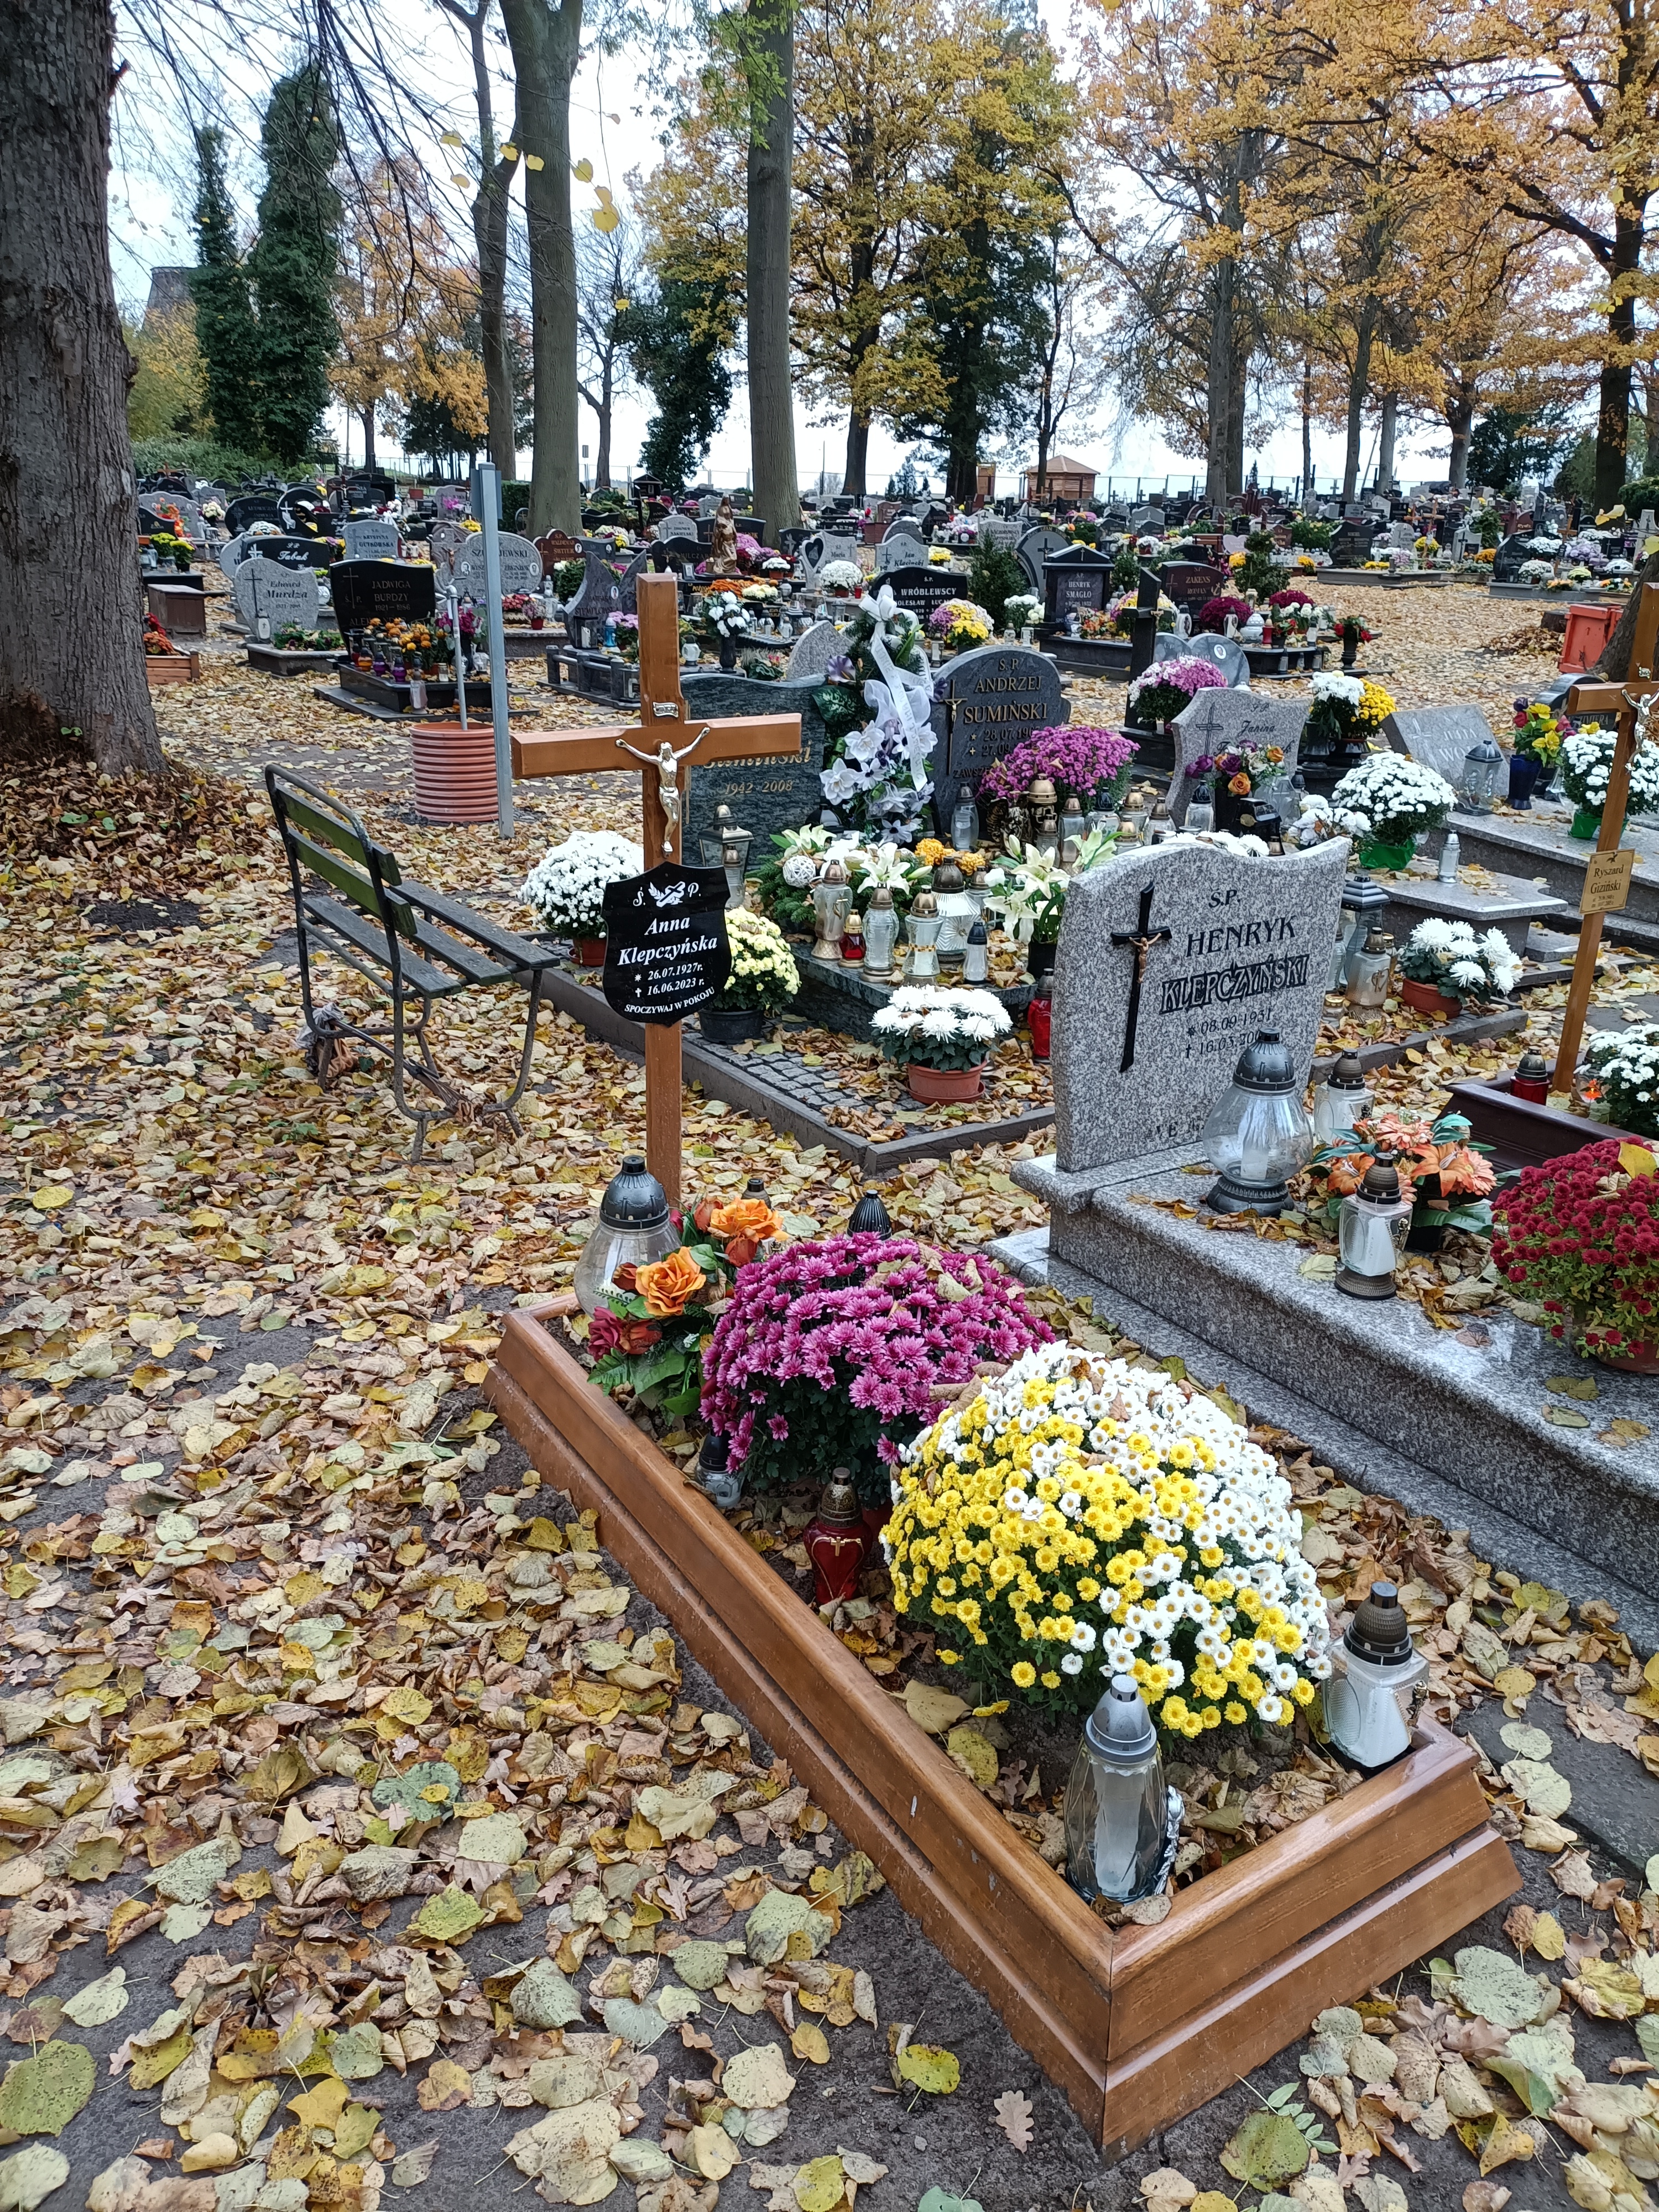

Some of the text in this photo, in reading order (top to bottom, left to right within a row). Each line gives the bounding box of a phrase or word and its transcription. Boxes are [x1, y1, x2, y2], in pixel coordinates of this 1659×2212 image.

[372, 580, 411, 589] JADWIGA
[901, 587, 957, 596] WRÓBLEWSCY
[374, 593, 409, 602] BURDZY
[975, 676, 1042, 692] ANDRZEJ
[964, 700, 1048, 723] SUMIŃSKI
[1237, 720, 1275, 736] Janina
[725, 780, 794, 796] 1942 2008
[1593, 864, 1624, 879] Ryszard
[1590, 879, 1622, 894] Giziński
[644, 917, 690, 936] Anna
[1186, 916, 1297, 958] HENRYK
[617, 935, 717, 966] Klepczyńska
[1161, 953, 1310, 1014] KLEPCZYŃSKI
[624, 987, 715, 1014] SPOCZYWAJ W POKOJU
